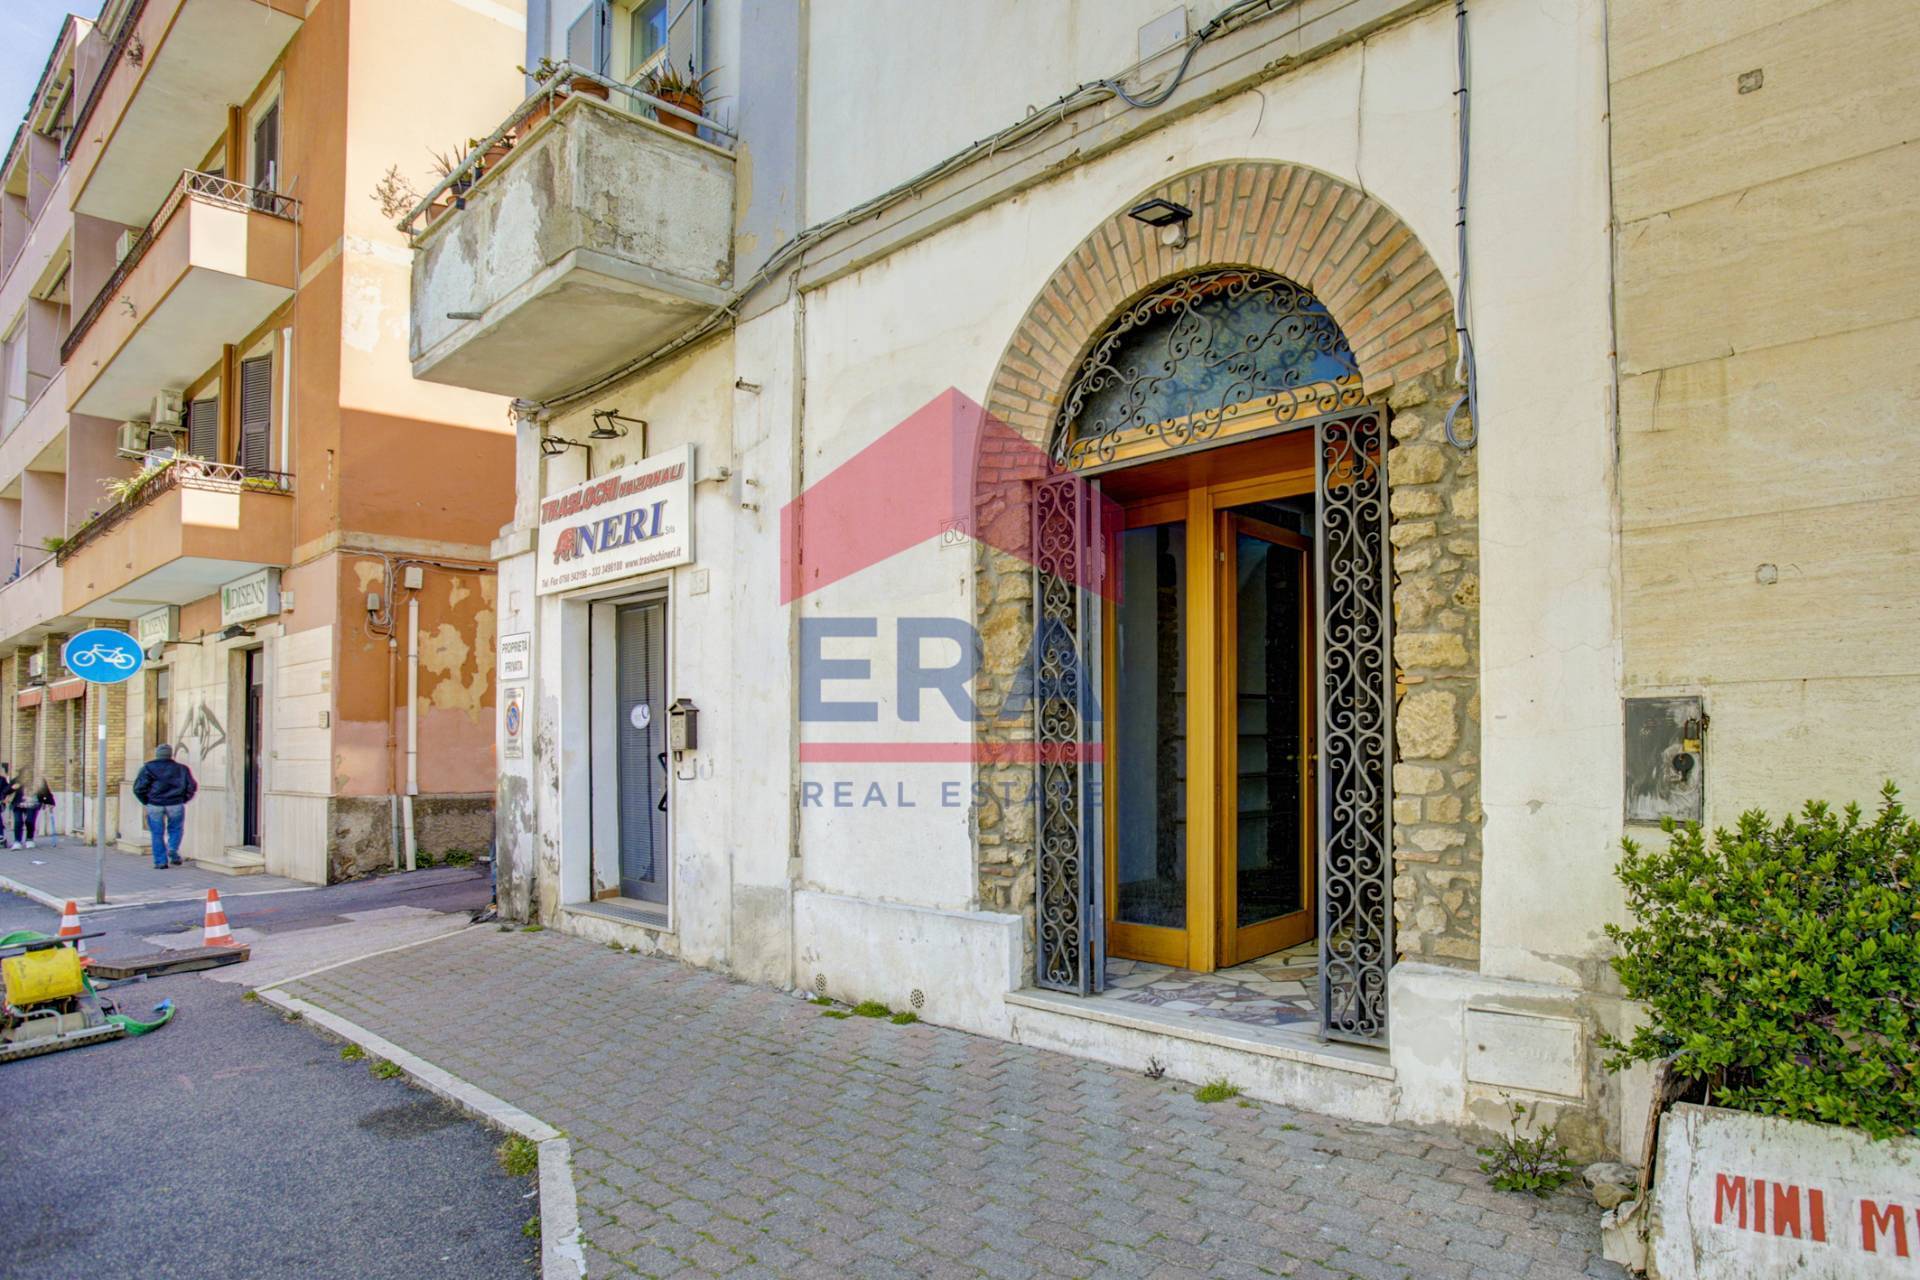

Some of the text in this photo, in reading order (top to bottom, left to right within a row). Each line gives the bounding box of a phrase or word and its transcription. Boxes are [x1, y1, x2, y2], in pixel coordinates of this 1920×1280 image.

[541, 462, 685, 524] TRASLOCHI NAZIONALI
[574, 499, 669, 558] NERI
[1714, 1173, 1827, 1243] MINI
